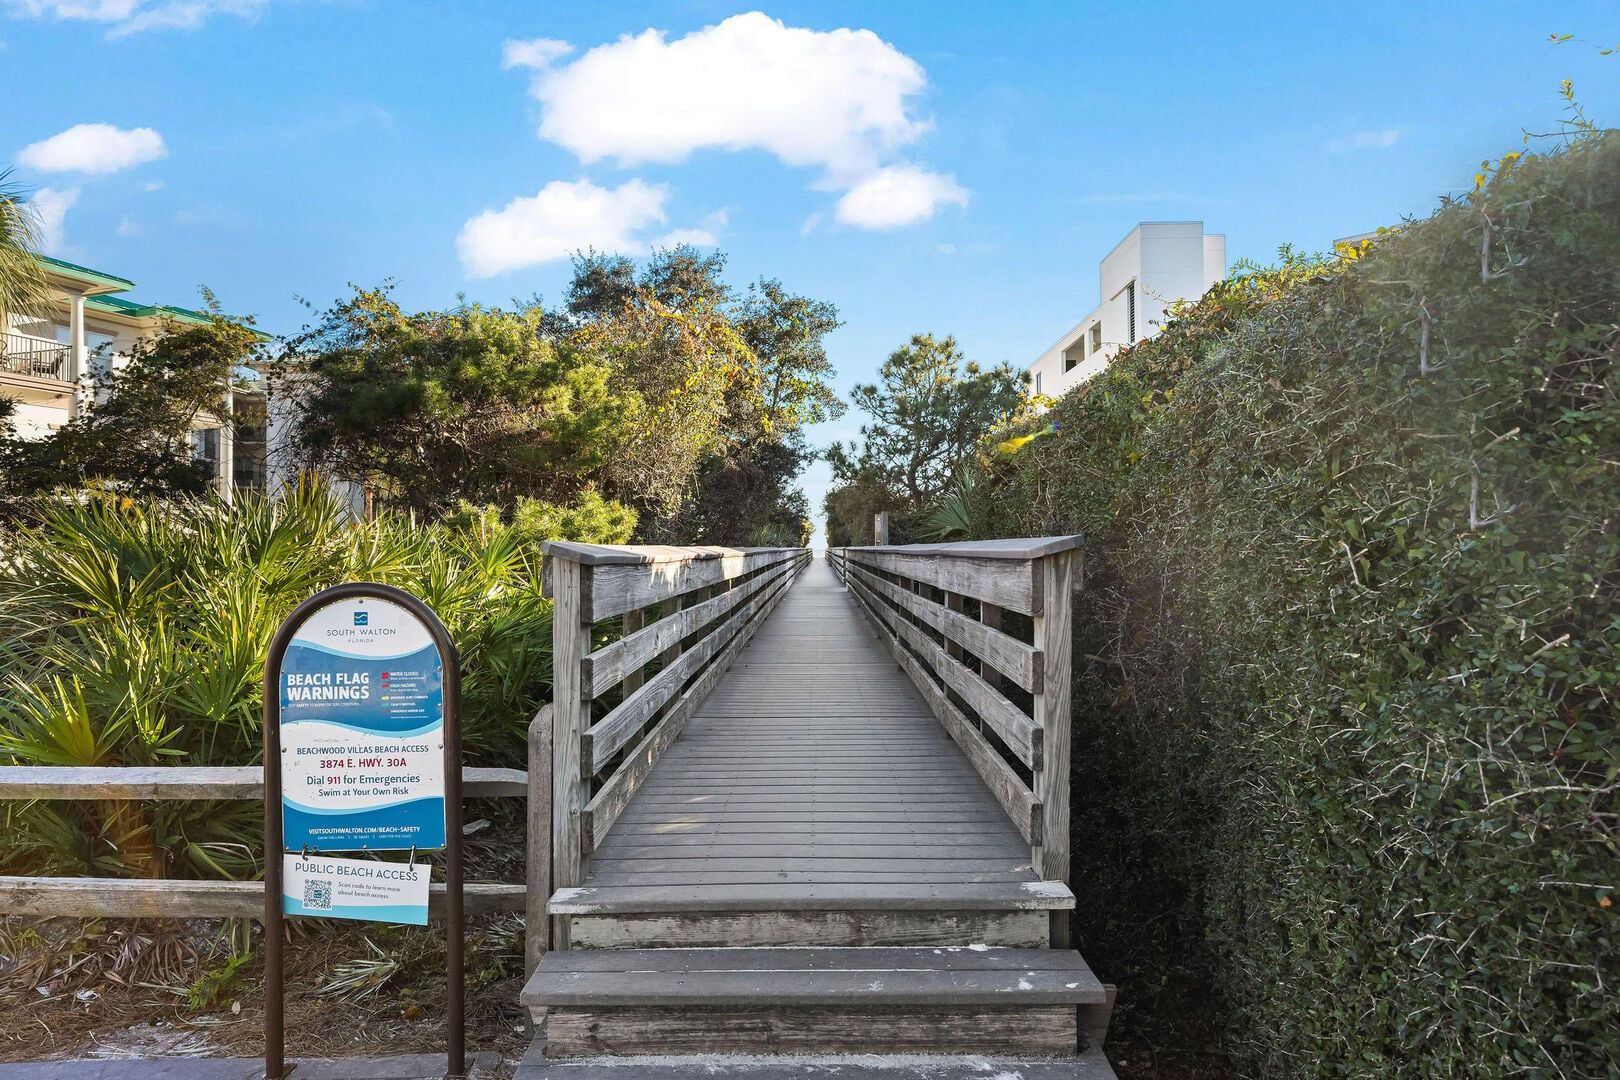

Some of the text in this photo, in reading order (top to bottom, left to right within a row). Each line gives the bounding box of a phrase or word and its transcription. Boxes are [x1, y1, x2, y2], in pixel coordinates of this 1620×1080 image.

[326, 628, 397, 637] SOUTH WALTON
[287, 672, 370, 686] BEACH FLAG
[287, 685, 370, 701] WARNINGS
[296, 744, 429, 755] BEACHWOOD VILLAS BEACH ACCESS
[319, 757, 407, 769] 3874 E. HWY. 30A
[306, 773, 421, 786] Dial 911 for Emergencies
[318, 788, 341, 797] Swim
[352, 788, 371, 796] Your
[372, 787, 391, 795] Own
[392, 786, 409, 795] Risk
[308, 826, 421, 835] VISITSOUTHWALTON.COM/BEACH-SAFETY
[295, 862, 418, 882] PUBLIC BEACH ACCESS
